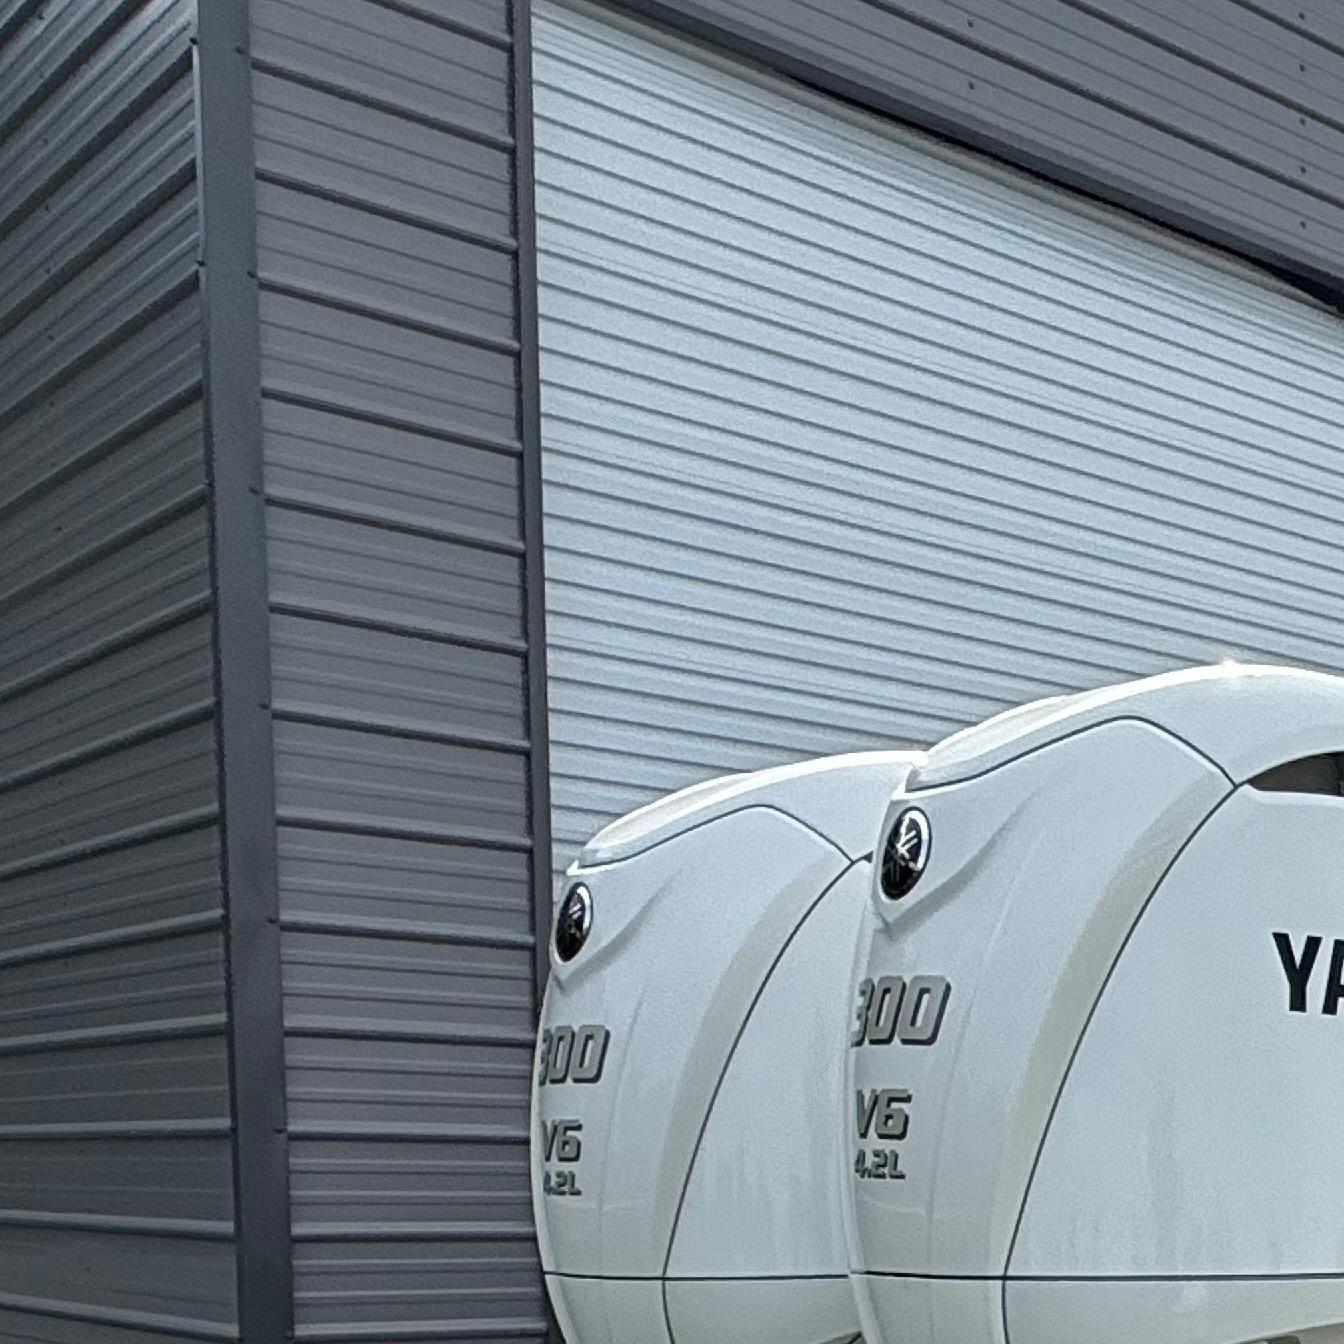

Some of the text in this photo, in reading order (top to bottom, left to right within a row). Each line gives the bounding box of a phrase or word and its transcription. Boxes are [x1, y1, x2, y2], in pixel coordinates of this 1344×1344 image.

[856, 1088, 914, 1140] V6
[541, 1119, 583, 1162] V6
[854, 1149, 906, 1180] 4.2L
